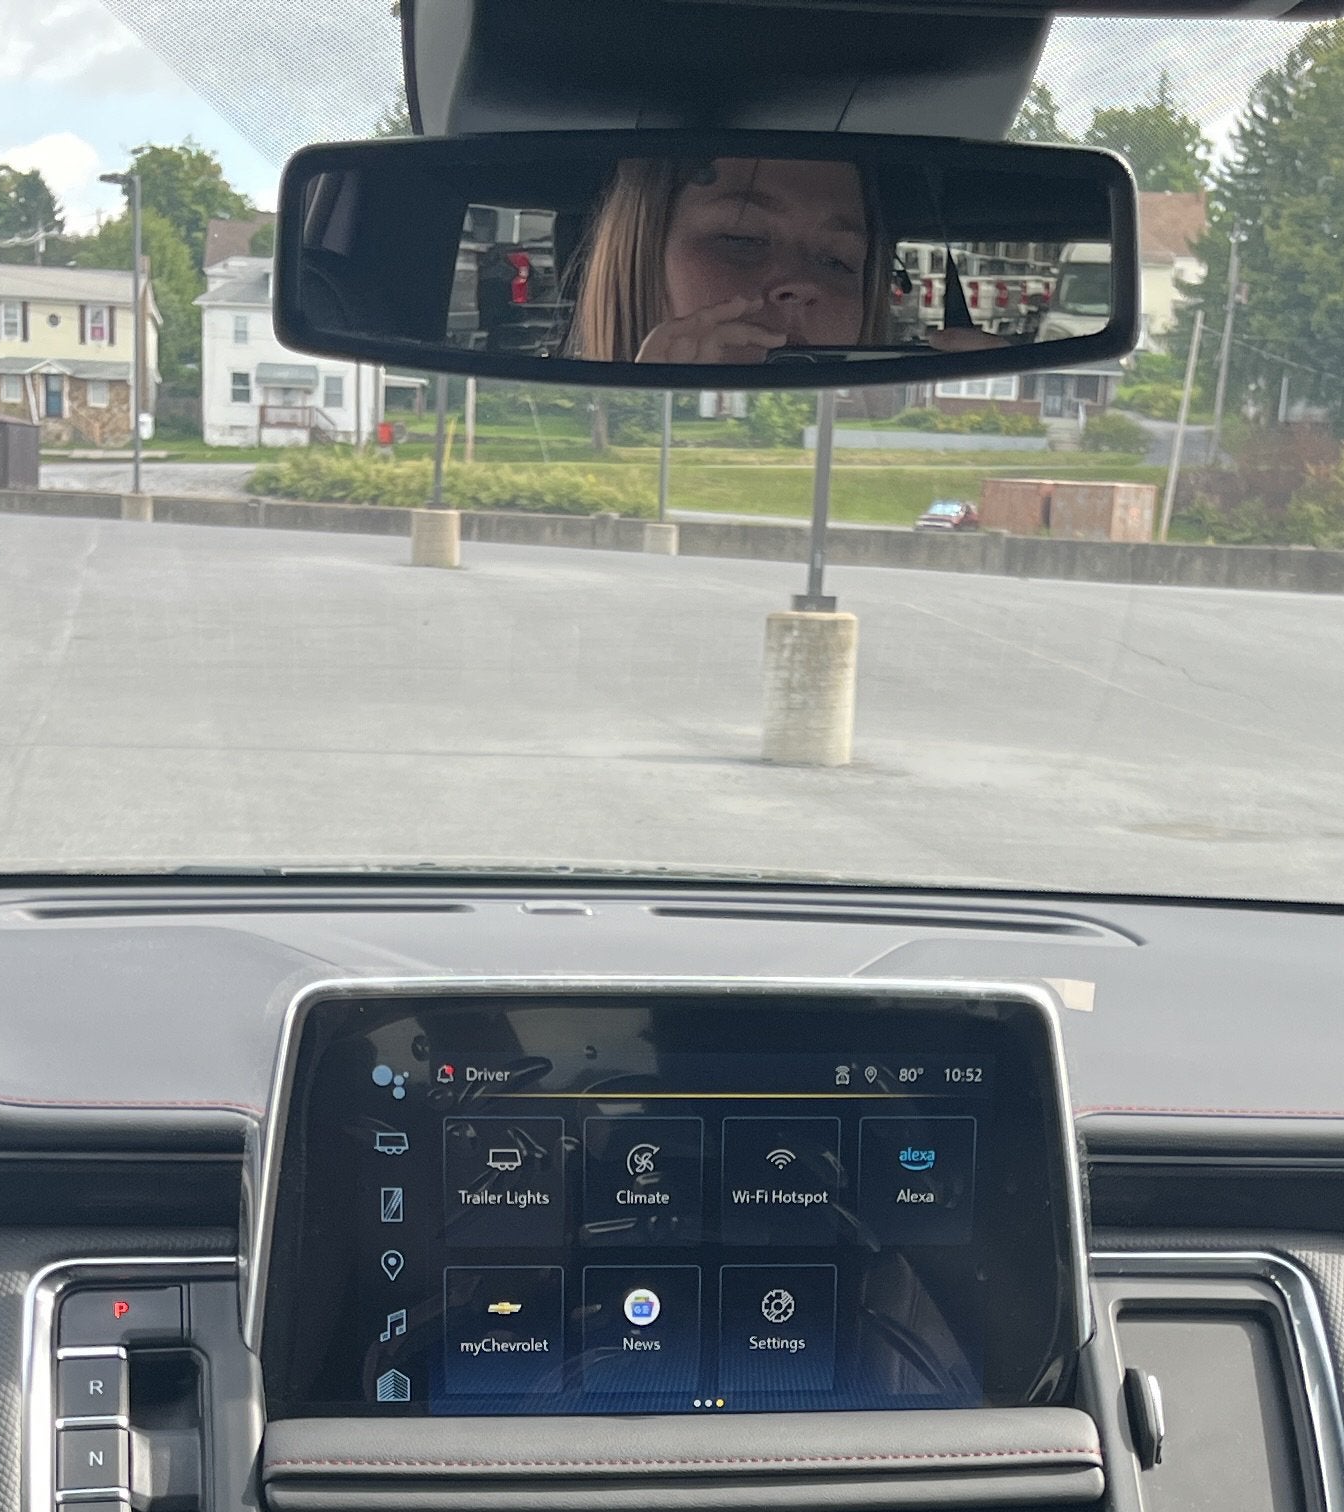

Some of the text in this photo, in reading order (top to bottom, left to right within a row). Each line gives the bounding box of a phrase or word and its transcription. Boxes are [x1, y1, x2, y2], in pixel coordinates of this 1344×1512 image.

[465, 1067, 510, 1082] Driver
[944, 1068, 983, 1083] 10:52
[899, 1147, 935, 1161] alexa
[458, 1190, 550, 1209] Trailer Lights
[616, 1190, 670, 1205] Climate
[732, 1190, 828, 1207] Wi-Fi Hotspot
[896, 1189, 935, 1203] Alexa
[112, 1301, 130, 1319] P
[460, 1337, 549, 1356] myChevrolet
[622, 1338, 661, 1351] News
[749, 1335, 806, 1353] Settings
[89, 1380, 104, 1395] R
[88, 1451, 104, 1467] N
